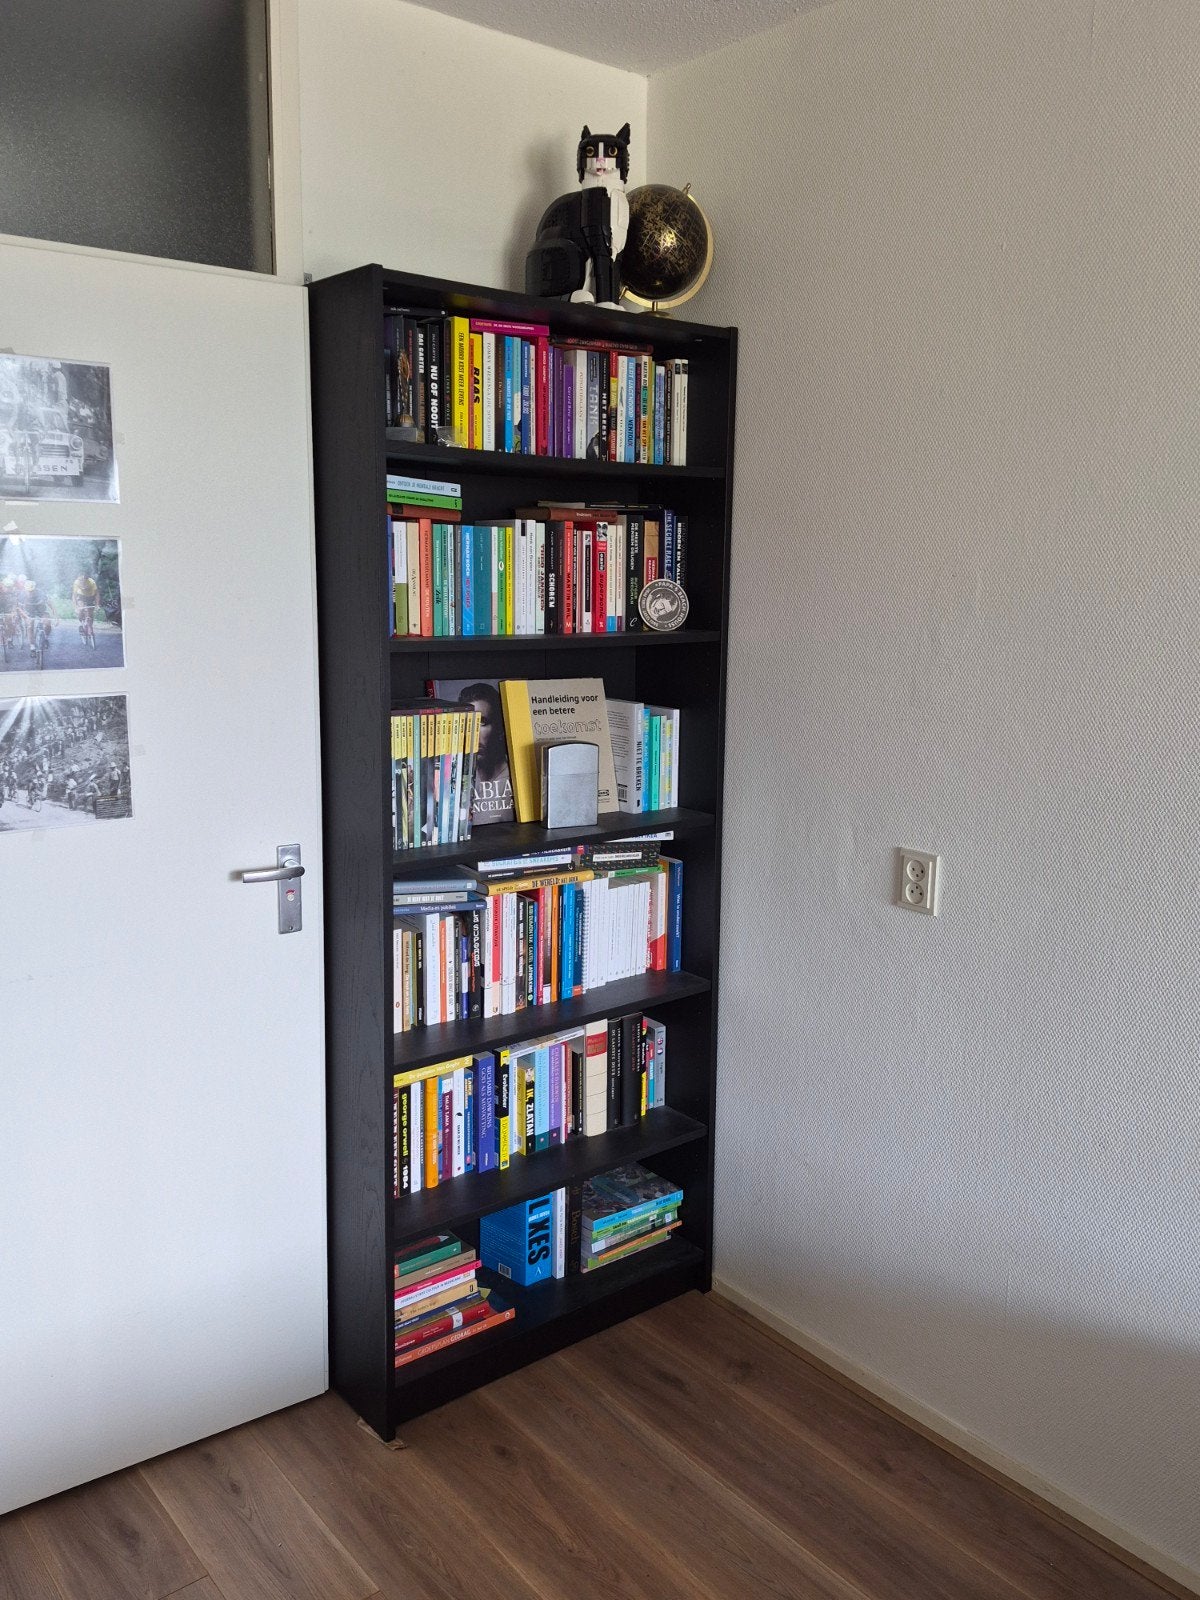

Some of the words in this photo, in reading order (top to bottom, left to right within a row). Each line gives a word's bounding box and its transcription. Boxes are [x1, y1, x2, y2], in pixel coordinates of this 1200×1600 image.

[430, 365, 438, 380] NU
[430, 382, 438, 396] OF
[590, 384, 598, 425] TANK
[676, 551, 681, 562] EN
[532, 694, 580, 704] Handleiding
[534, 719, 602, 735] toekomst
[474, 779, 513, 800] ABIA
[473, 799, 514, 812] NCELLA
[526, 1088, 534, 1102] IK,
[526, 1104, 534, 1136] ZLATAN
